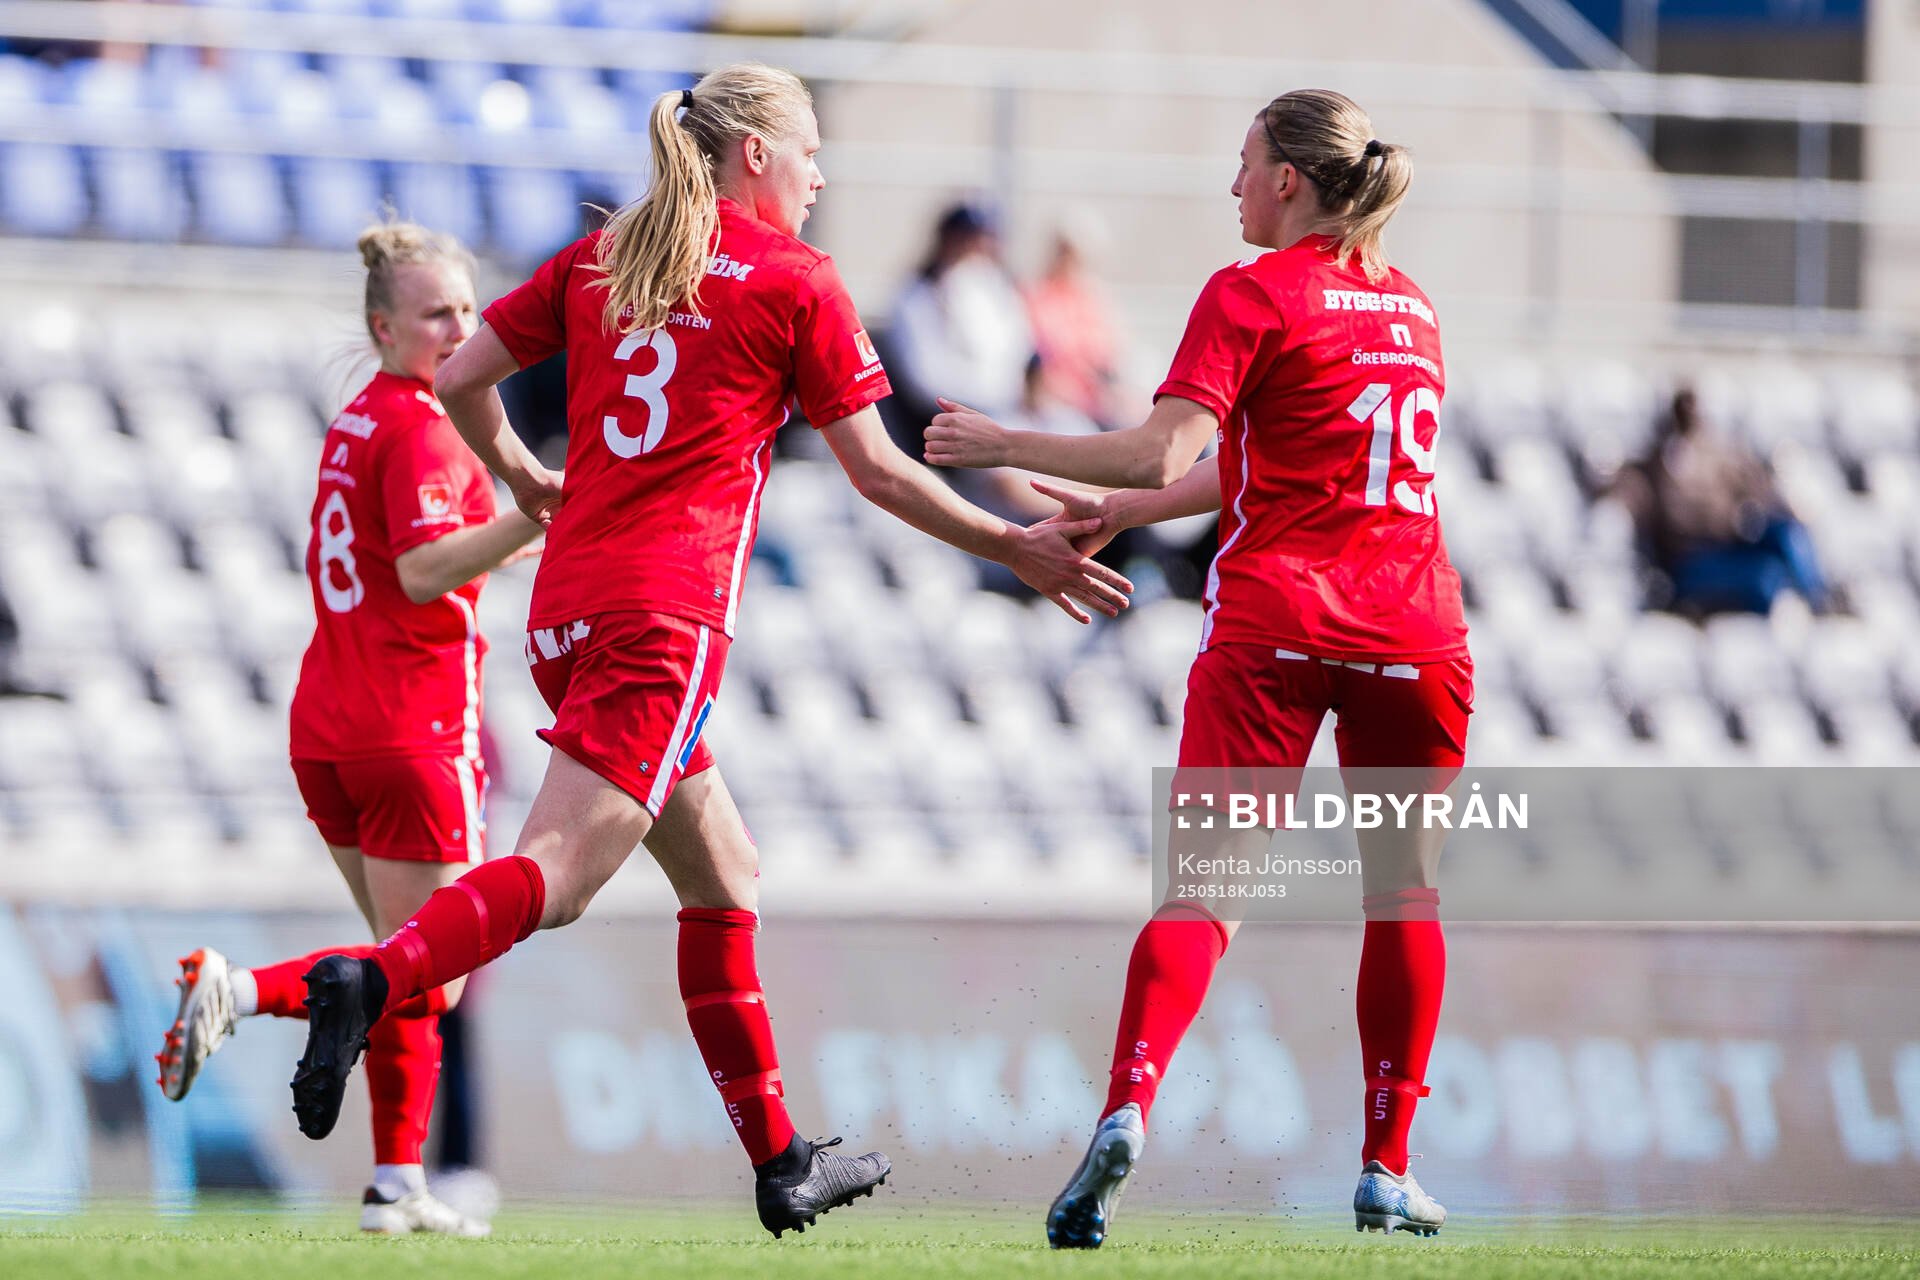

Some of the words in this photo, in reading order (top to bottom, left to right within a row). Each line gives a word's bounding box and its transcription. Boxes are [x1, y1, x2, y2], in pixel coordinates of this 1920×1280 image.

[603, 328, 677, 459] 3
[1346, 382, 1441, 516] 19
[319, 490, 365, 613] 8
[1374, 1060, 1392, 1120] umro
